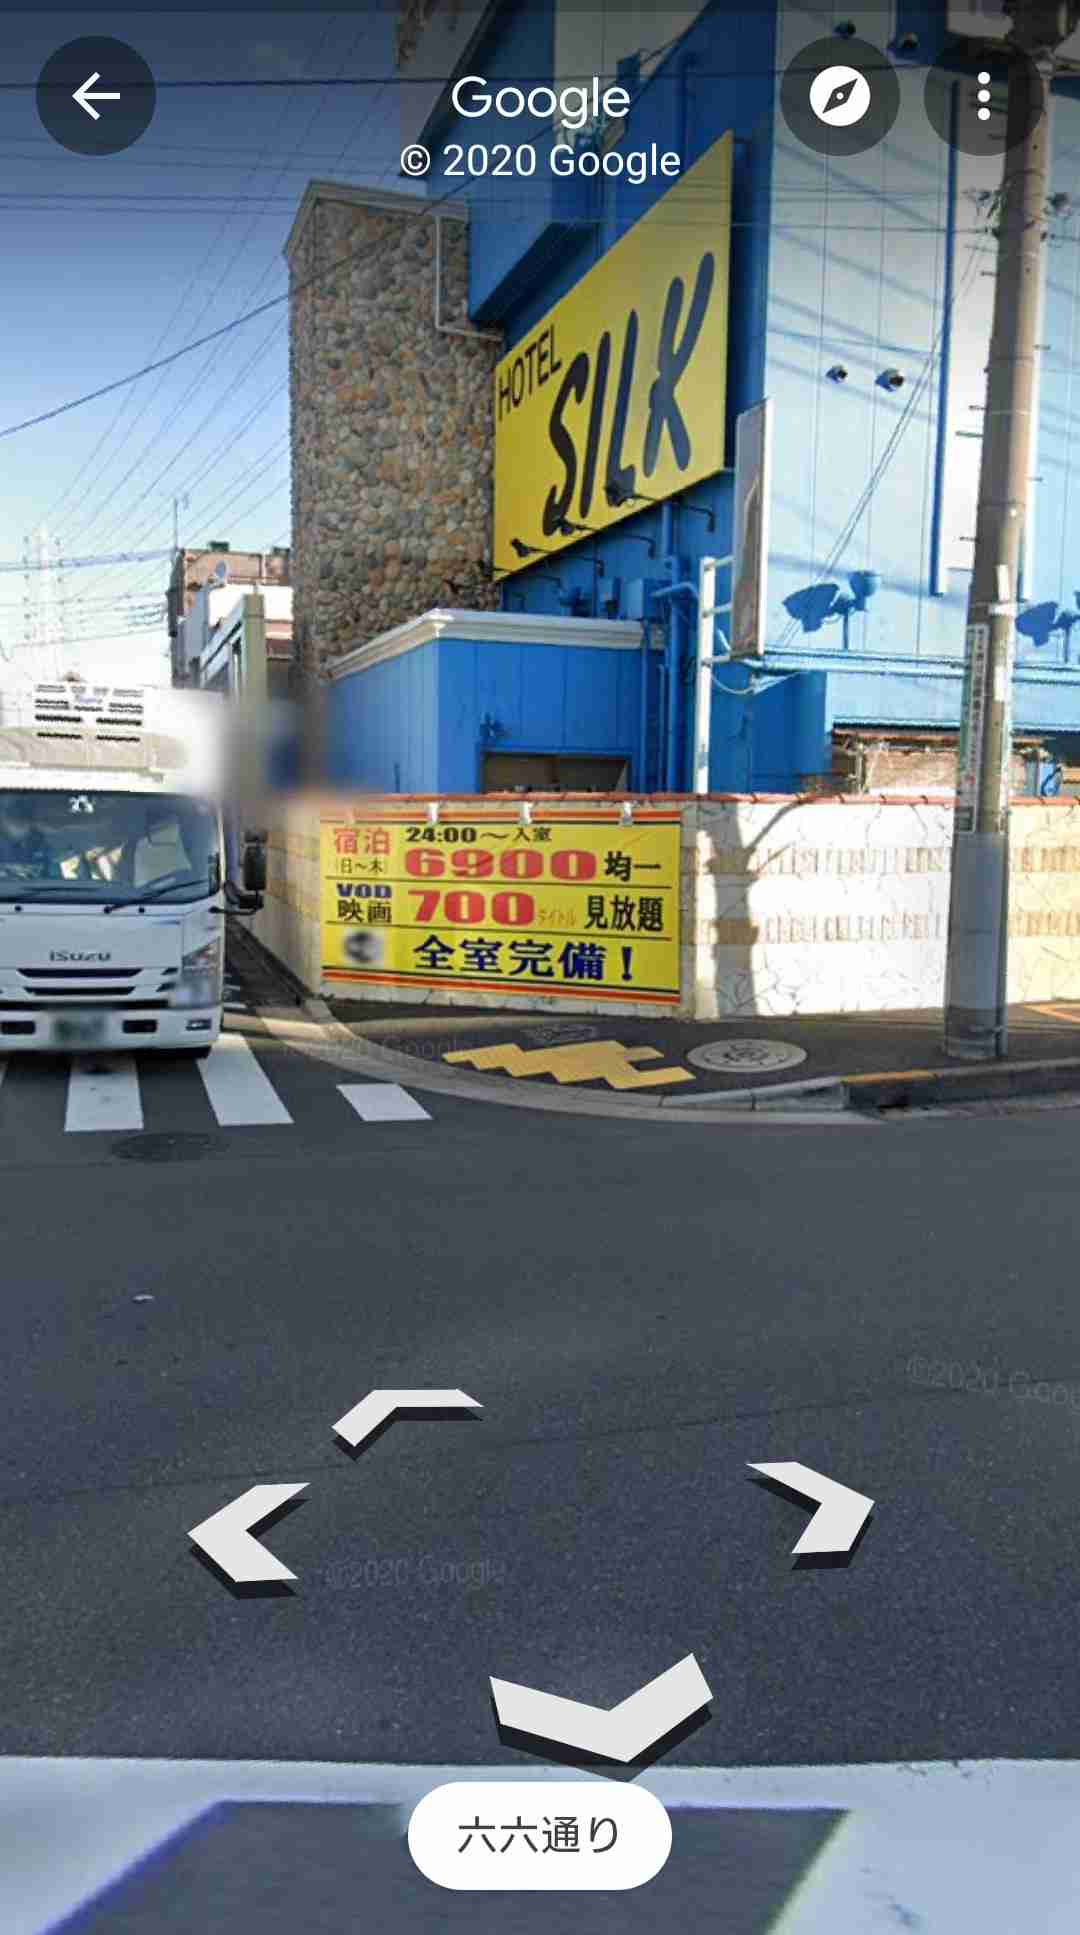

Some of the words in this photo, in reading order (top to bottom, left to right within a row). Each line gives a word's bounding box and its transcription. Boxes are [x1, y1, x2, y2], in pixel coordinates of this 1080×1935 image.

[498, 324, 562, 422] HOTEL
[542, 252, 715, 537] SILK
[334, 827, 391, 855] 宿泊
[405, 848, 597, 881] 6900
[336, 883, 392, 898] VOD
[337, 898, 391, 923] 映画
[408, 890, 535, 926] 700
[585, 895, 665, 932] 見放題
